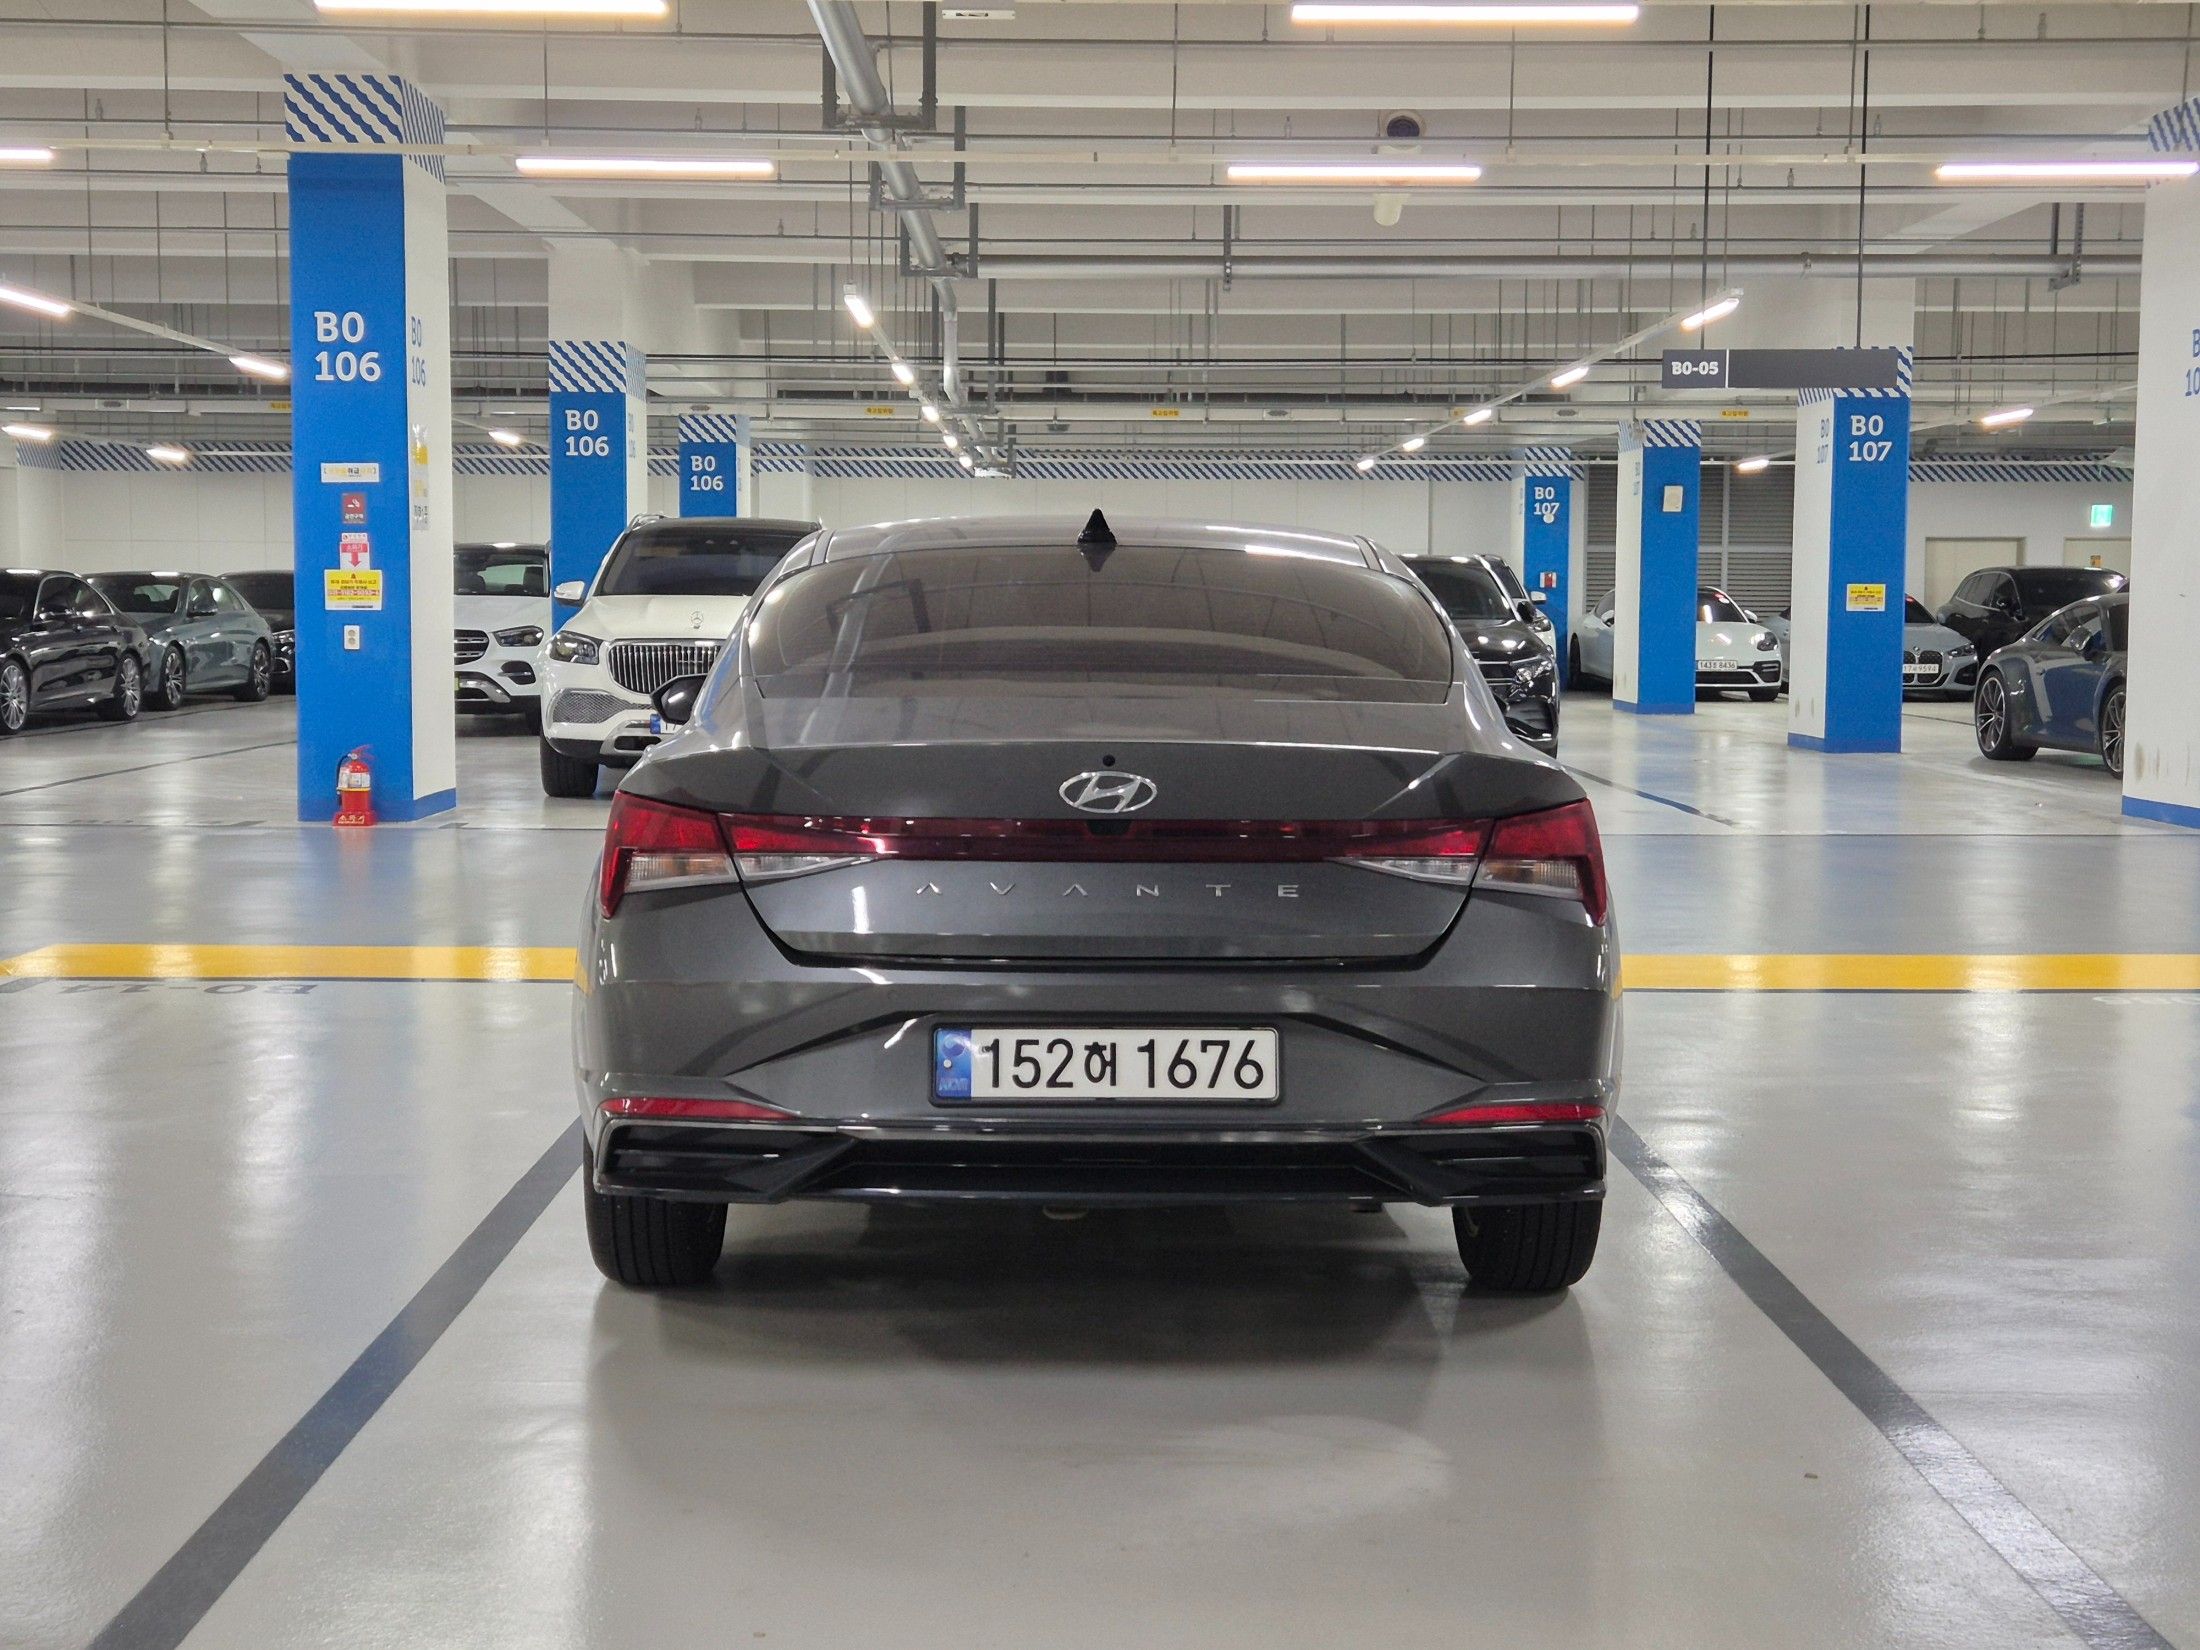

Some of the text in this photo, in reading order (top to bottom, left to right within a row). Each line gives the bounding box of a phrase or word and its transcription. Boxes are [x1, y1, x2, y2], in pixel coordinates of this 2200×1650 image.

[315, 351, 382, 382] 106
[411, 356, 426, 387] 106
[565, 435, 610, 457] 106
[1849, 441, 1893, 462] 107
[690, 475, 724, 491] 106
[1534, 502, 1560, 516] 107
[916, 881, 1300, 898] AVANTE
[981, 1038, 1264, 1090] 152허 1676
